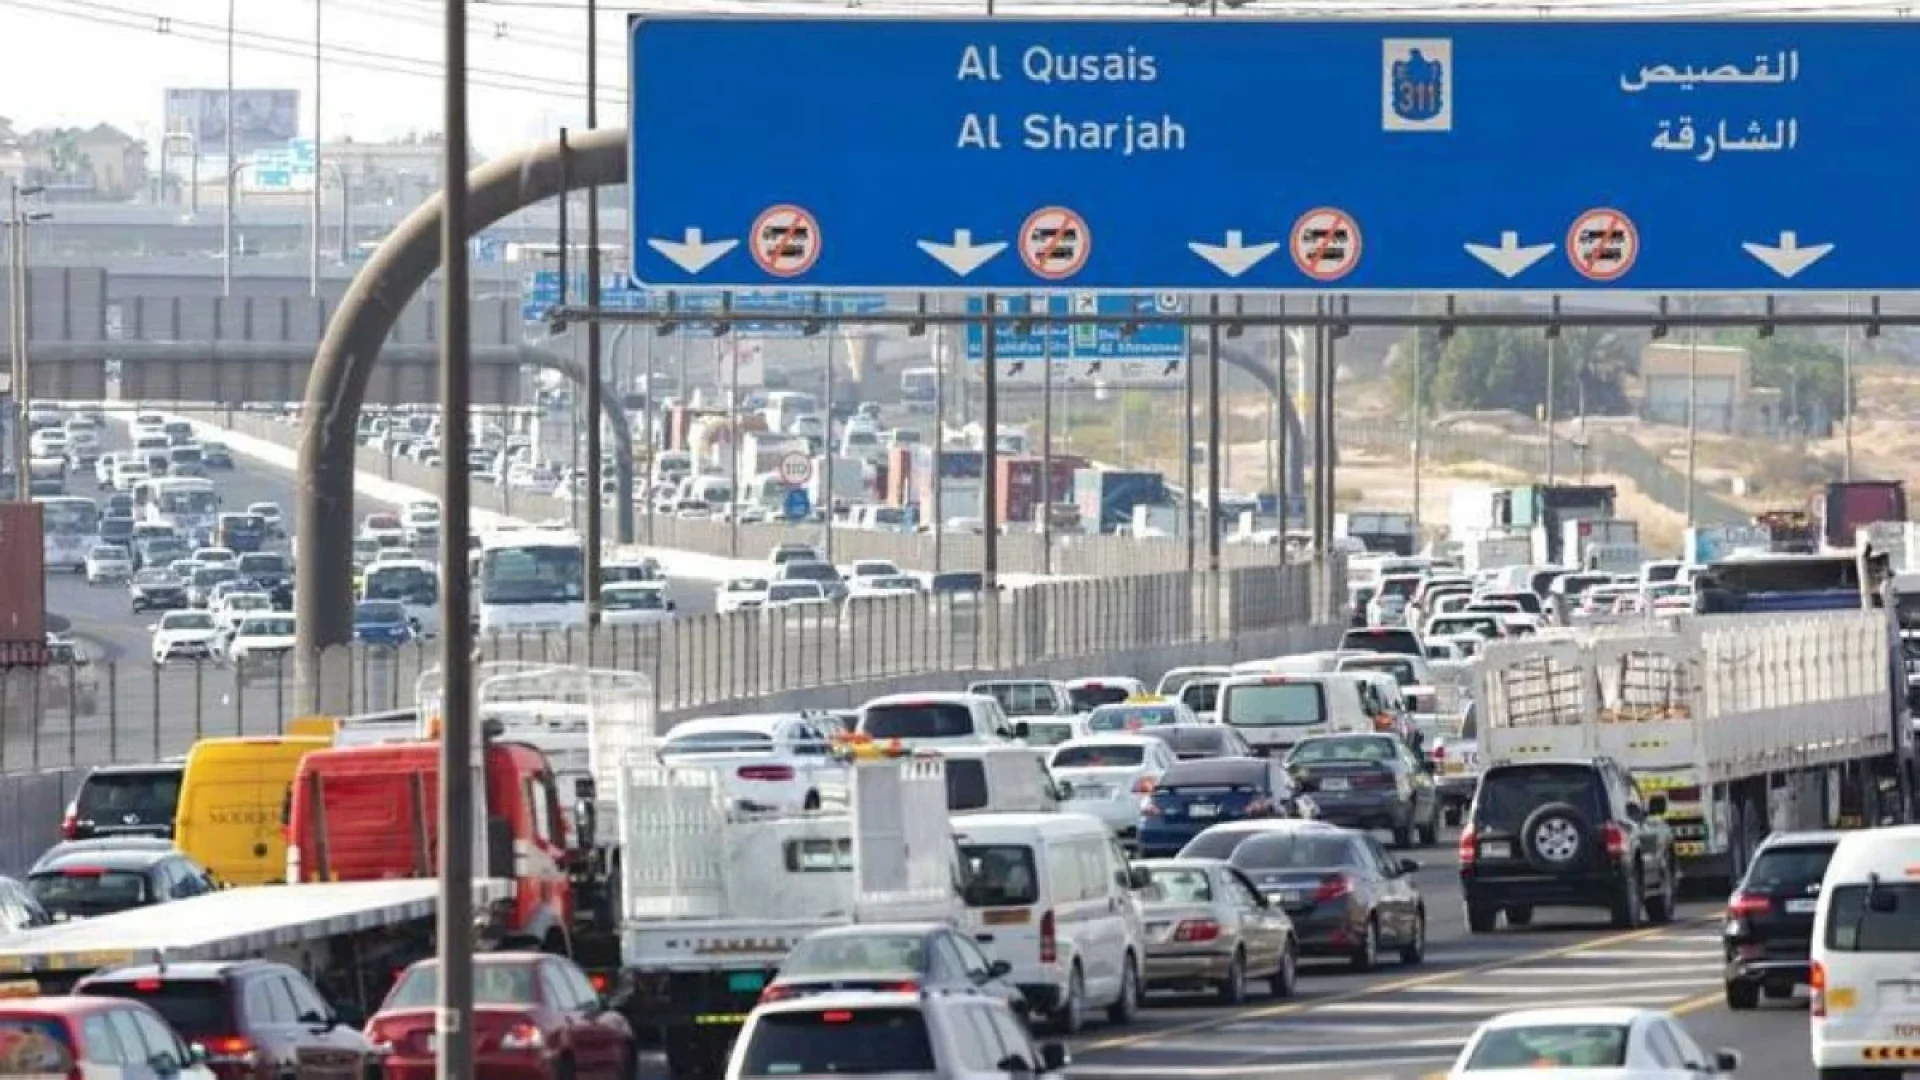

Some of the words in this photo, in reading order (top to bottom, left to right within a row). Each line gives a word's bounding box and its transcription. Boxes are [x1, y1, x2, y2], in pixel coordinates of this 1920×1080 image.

[957, 46, 1002, 81] Al
[1024, 46, 1156, 82] Qusais
[1620, 50, 1799, 92] القصيص
[1400, 81, 1435, 112] 311
[957, 114, 1001, 149] Al
[1024, 114, 1186, 155] Sharjah
[1651, 118, 1798, 161] الشارقة
